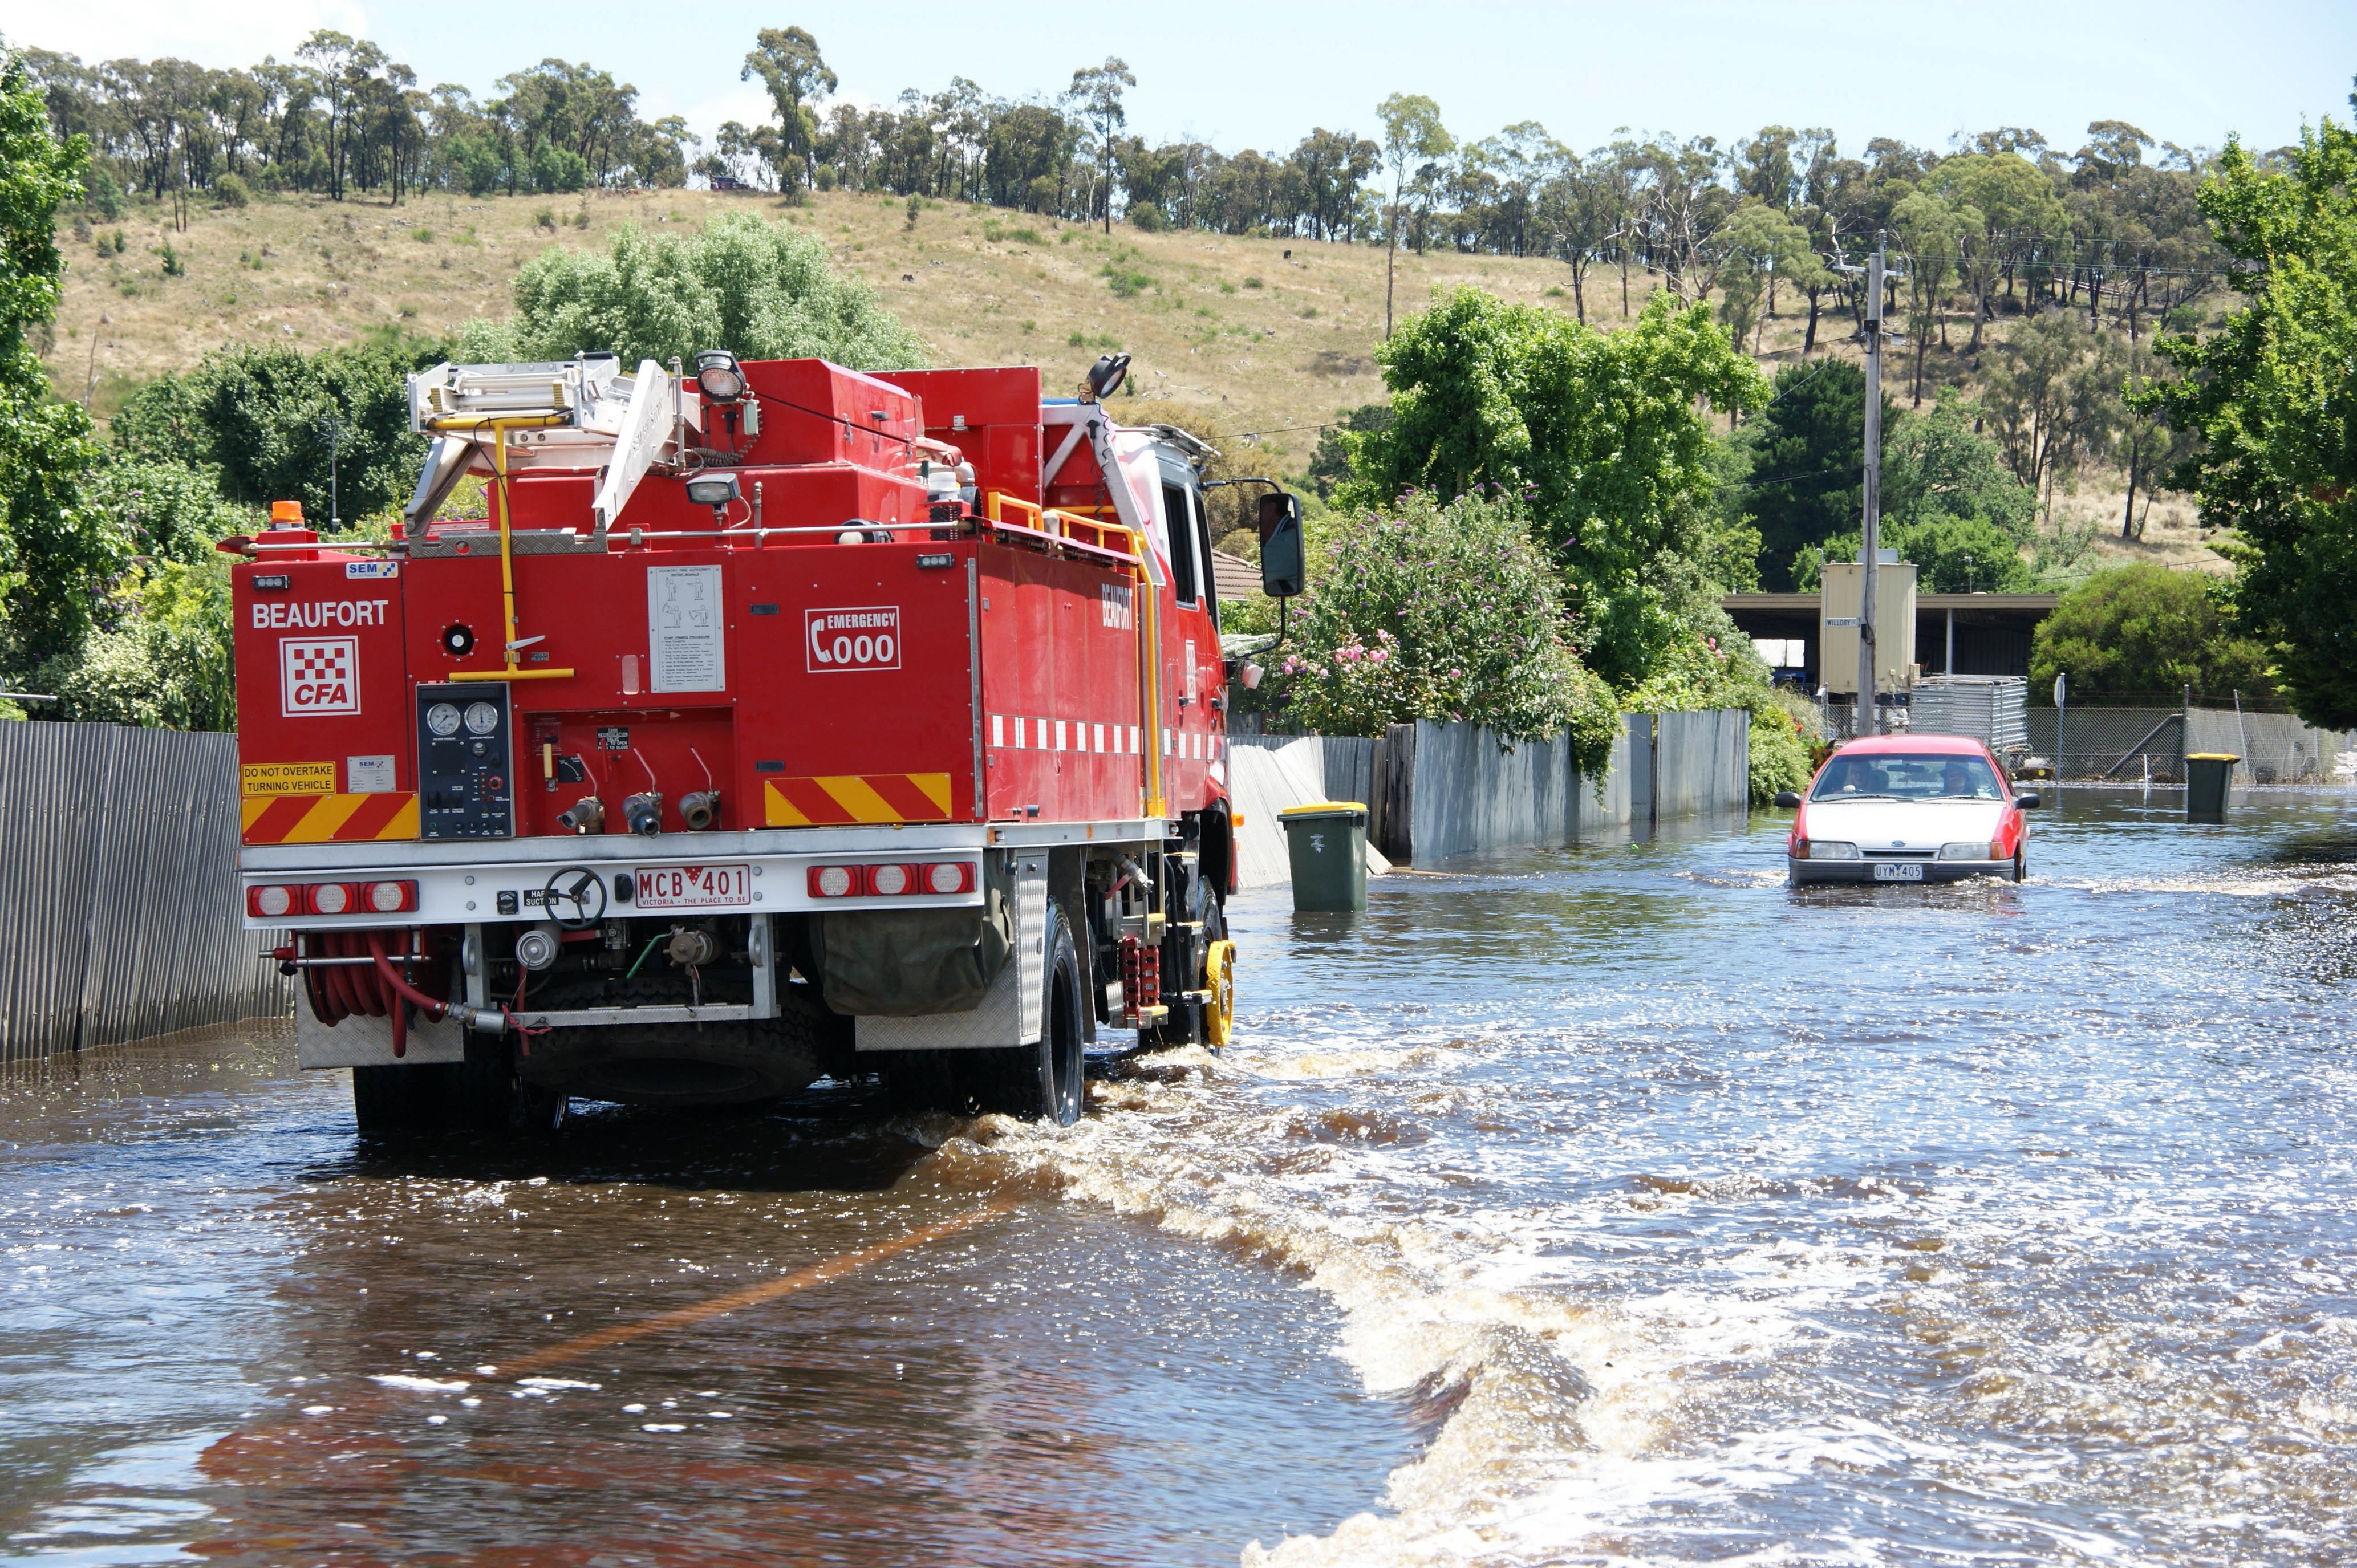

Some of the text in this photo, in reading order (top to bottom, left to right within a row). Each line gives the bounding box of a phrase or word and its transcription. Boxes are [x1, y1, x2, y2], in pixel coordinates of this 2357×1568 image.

[349, 564, 378, 573] SEM
[253, 600, 388, 628] BEAUFORT
[1102, 583, 1133, 630] BEAUFORT
[827, 613, 895, 629] EMERGENCY
[834, 634, 894, 664] 000
[294, 684, 348, 705] CFA
[245, 766, 332, 777] DO NOT OVERTAKE
[248, 780, 331, 791] TURNING VEHICLE
[1876, 867, 1920, 876] UYM 405
[639, 870, 743, 898] MCB 401
